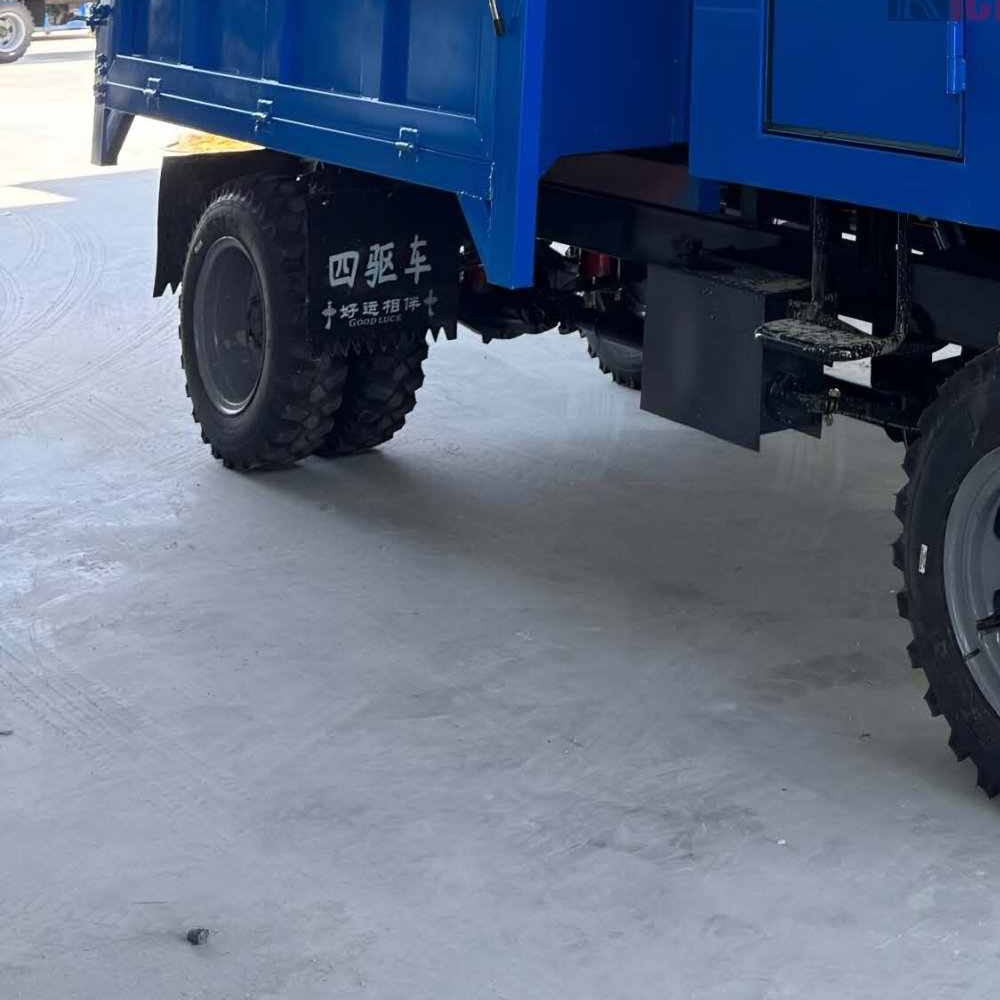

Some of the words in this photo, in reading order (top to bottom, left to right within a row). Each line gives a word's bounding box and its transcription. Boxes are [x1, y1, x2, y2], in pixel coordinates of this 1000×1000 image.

[328, 234, 432, 289] 四驱车
[339, 296, 422, 319] 好运相伴
[349, 317, 377, 327] GOOD
[378, 314, 402, 324] LUCK
